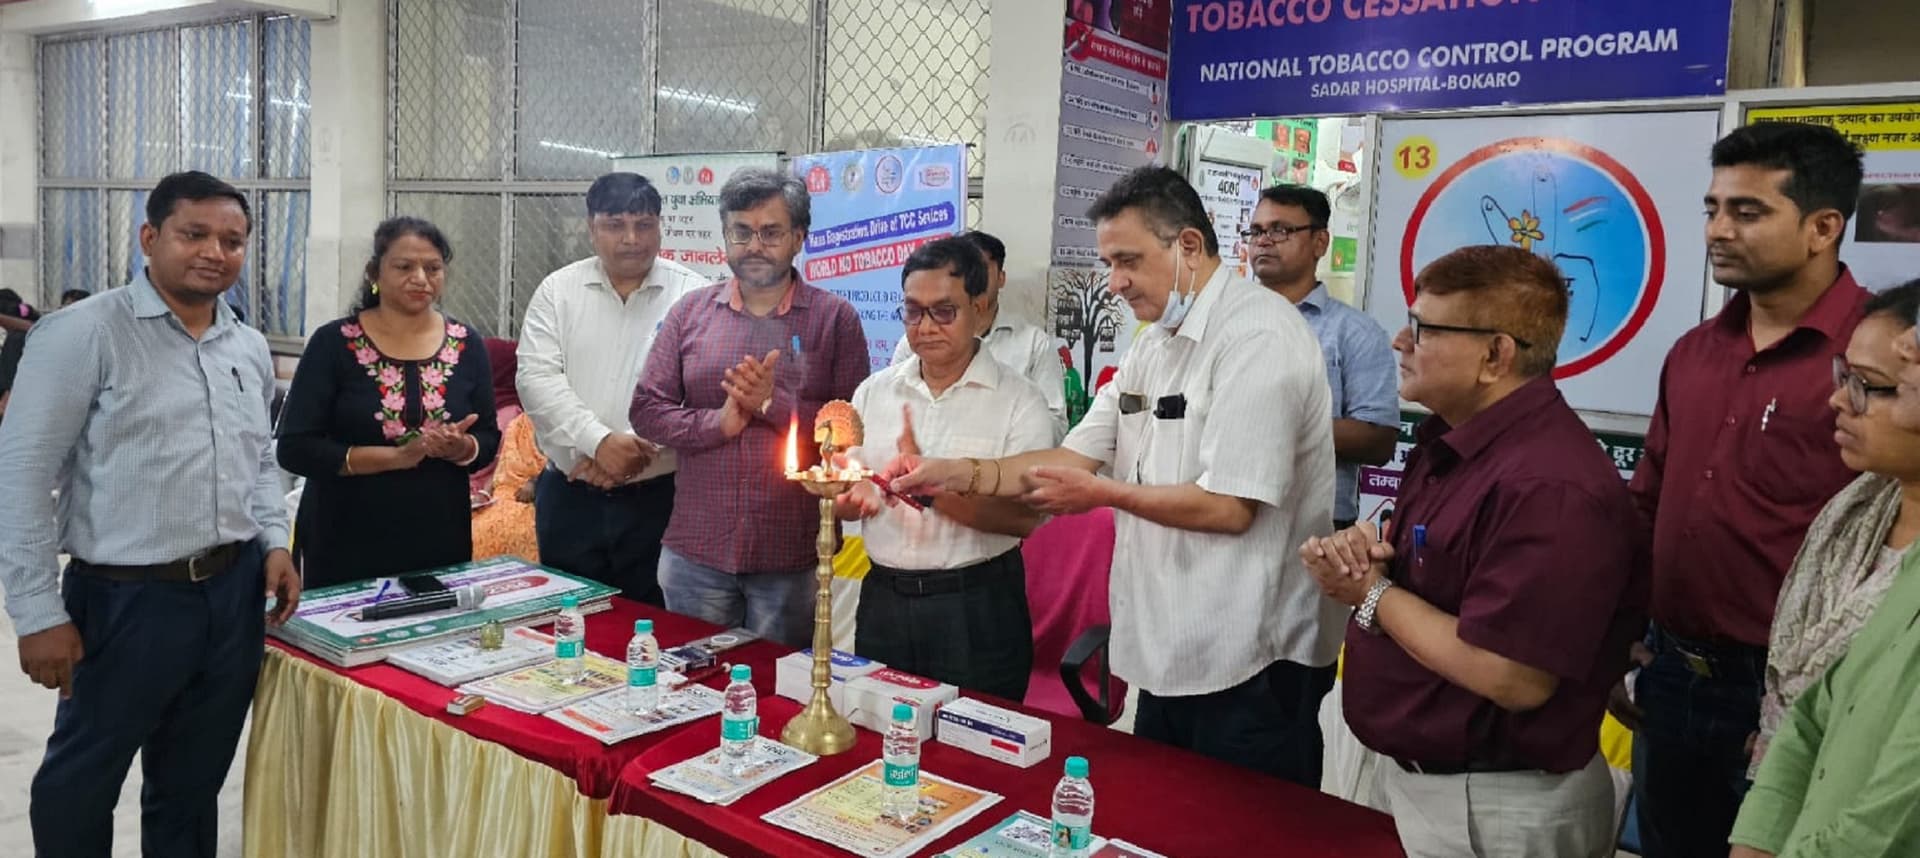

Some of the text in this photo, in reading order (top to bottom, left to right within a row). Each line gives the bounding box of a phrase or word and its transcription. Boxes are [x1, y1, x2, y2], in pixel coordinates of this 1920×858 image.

[1187, 0, 1331, 32] TOBACCO
[1200, 28, 1678, 82] NATIONAL TOBACCO CONTROL PROGRAM
[1311, 71, 1521, 98] SADAR HOSPITAL-BOKARO
[1399, 146, 1431, 170] 13
[899, 210, 917, 229] TCC
[809, 258, 838, 280] WORLD
[838, 254, 852, 273] NO
[852, 247, 896, 271] TOBACCO
